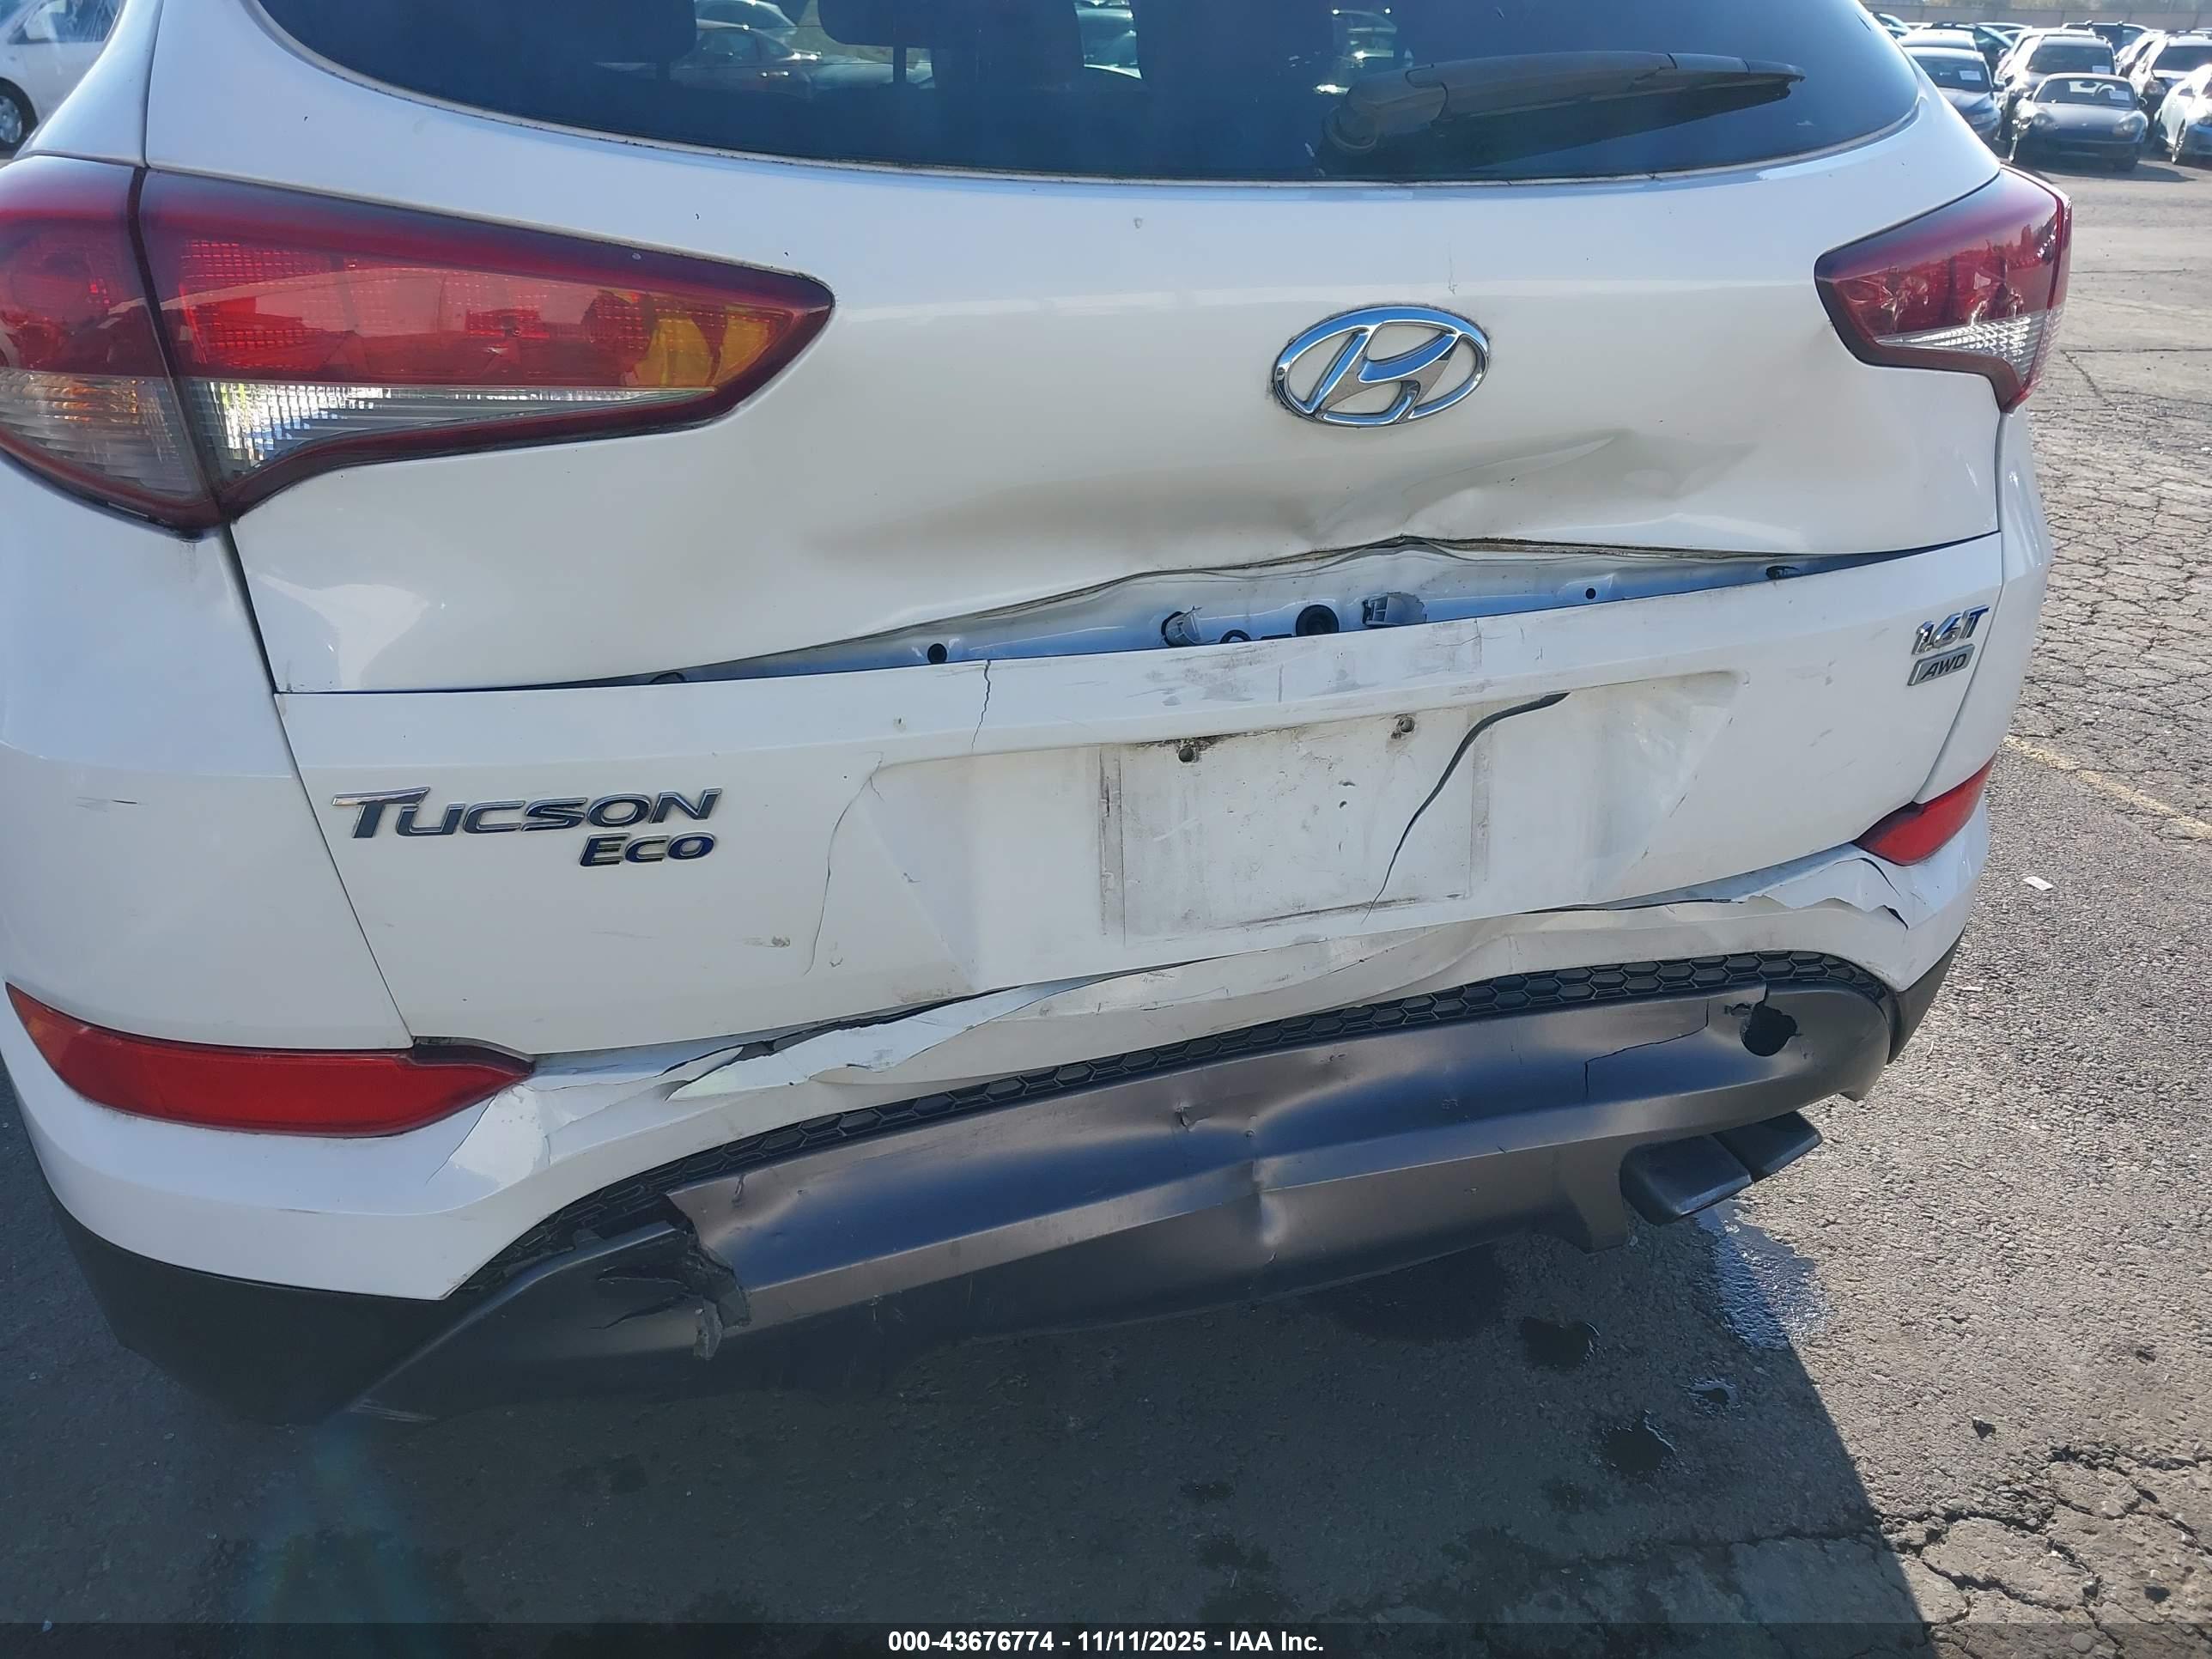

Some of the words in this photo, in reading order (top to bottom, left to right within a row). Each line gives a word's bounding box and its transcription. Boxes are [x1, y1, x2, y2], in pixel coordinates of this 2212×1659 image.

[1911, 605, 1990, 654] 1.6T
[1920, 653, 1967, 681] AWD
[332, 787, 722, 838] TUCSON
